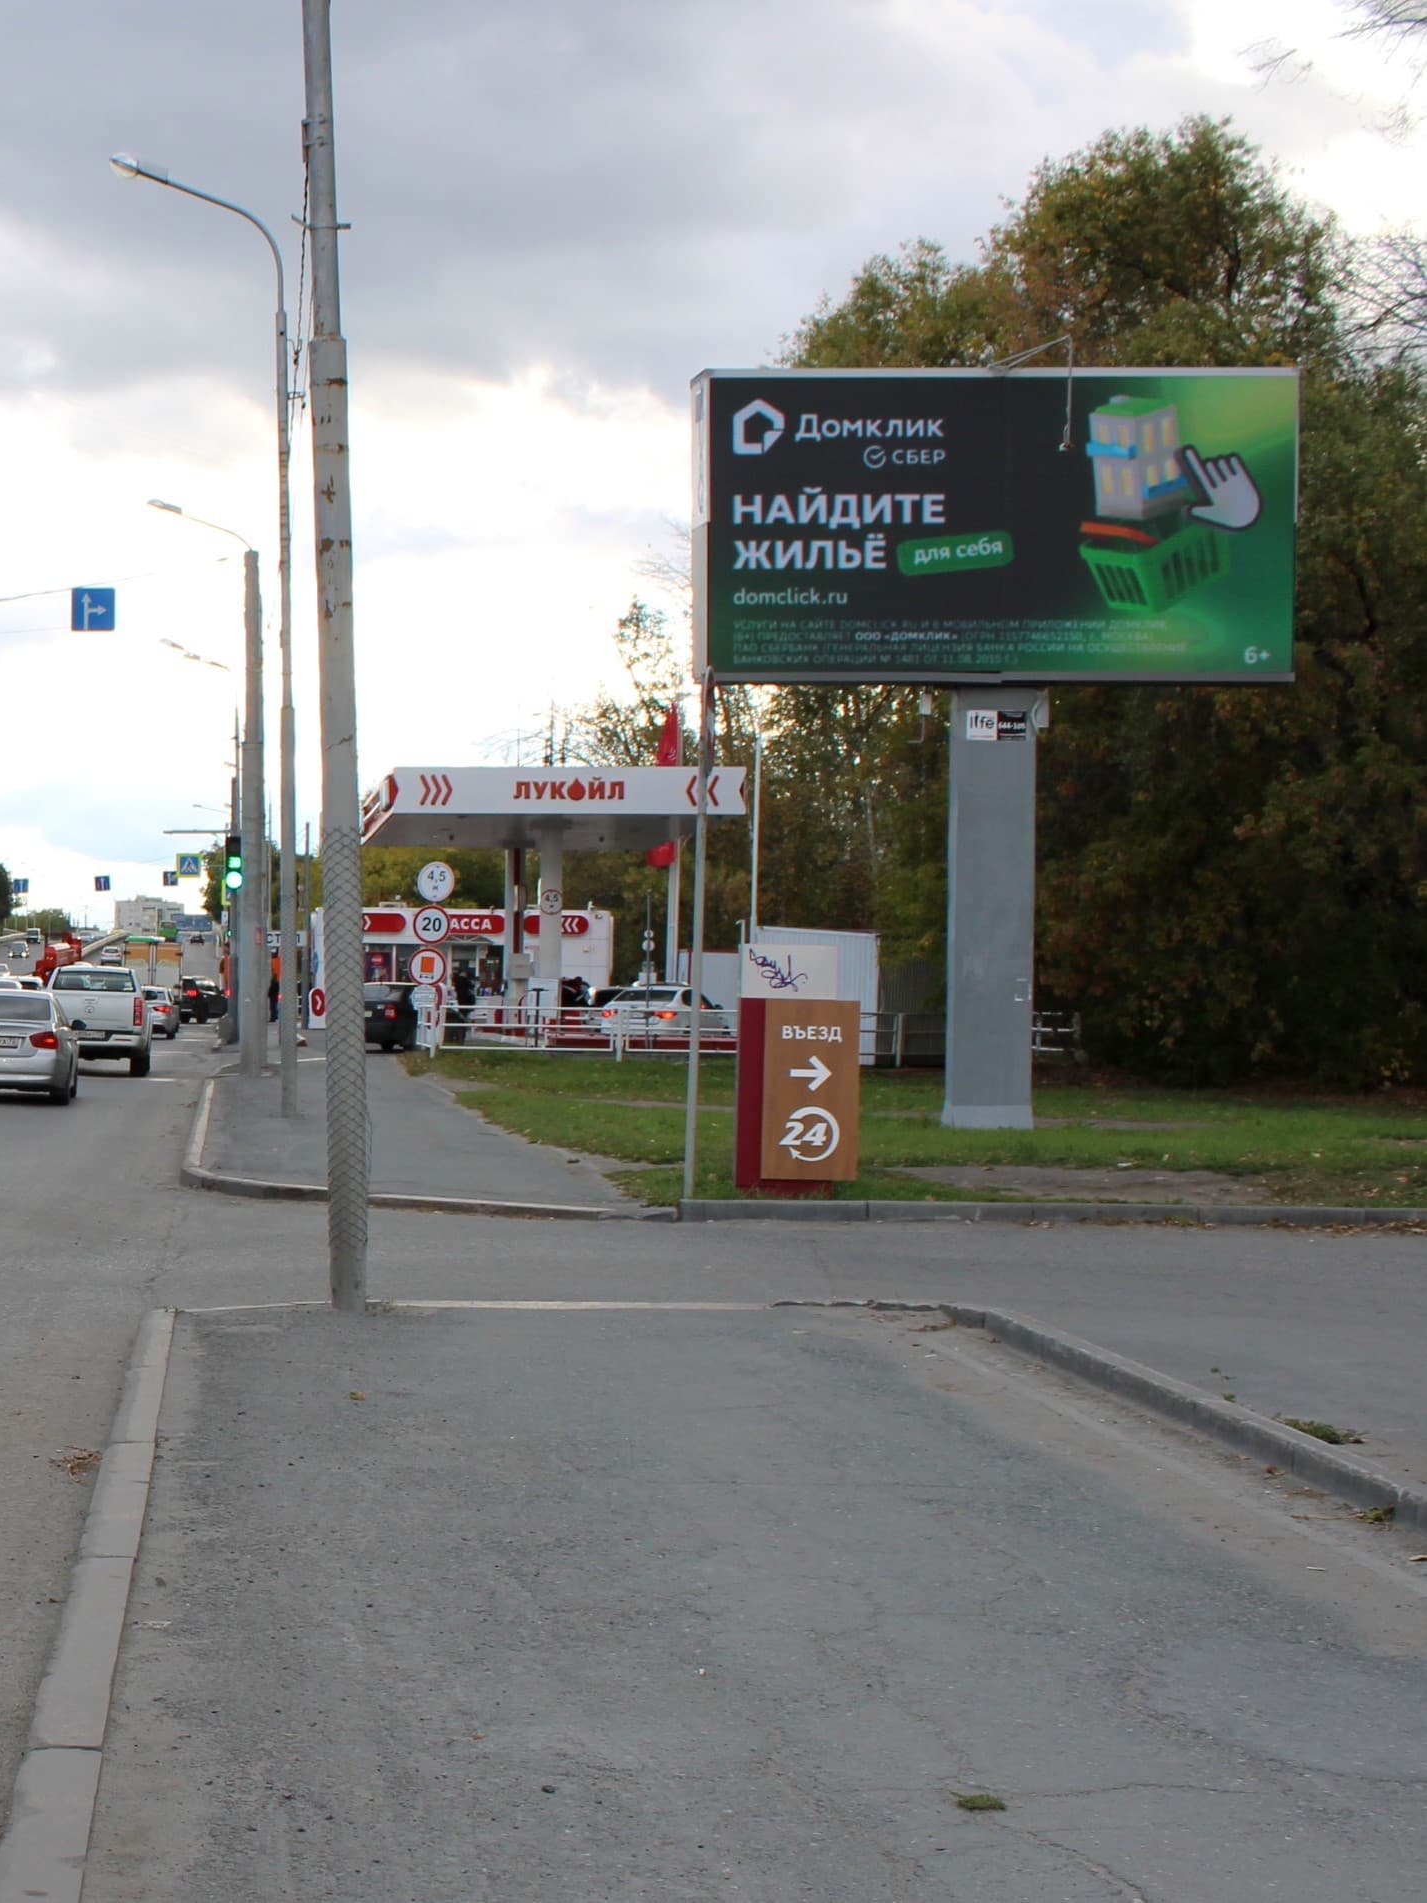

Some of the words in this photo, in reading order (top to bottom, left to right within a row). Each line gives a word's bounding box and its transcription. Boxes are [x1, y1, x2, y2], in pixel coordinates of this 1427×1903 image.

[795, 413, 944, 442] Домклик
[892, 449, 946, 465] СБЕР
[732, 486, 946, 530] НАЙДИТЕ
[732, 534, 887, 570] ЖИЛЬЁ
[914, 541, 951, 566] для
[956, 537, 1004, 558] себя
[733, 587, 848, 605] domclick.ru
[855, 631, 881, 641] ООО
[884, 631, 958, 641] «ДОМКЛИК»
[1244, 646, 1271, 664] 6+
[422, 917, 442, 933] 20
[449, 918, 493, 930] АССА
[781, 1025, 843, 1043] ВЪЕЗД
[779, 1121, 828, 1146] 24
